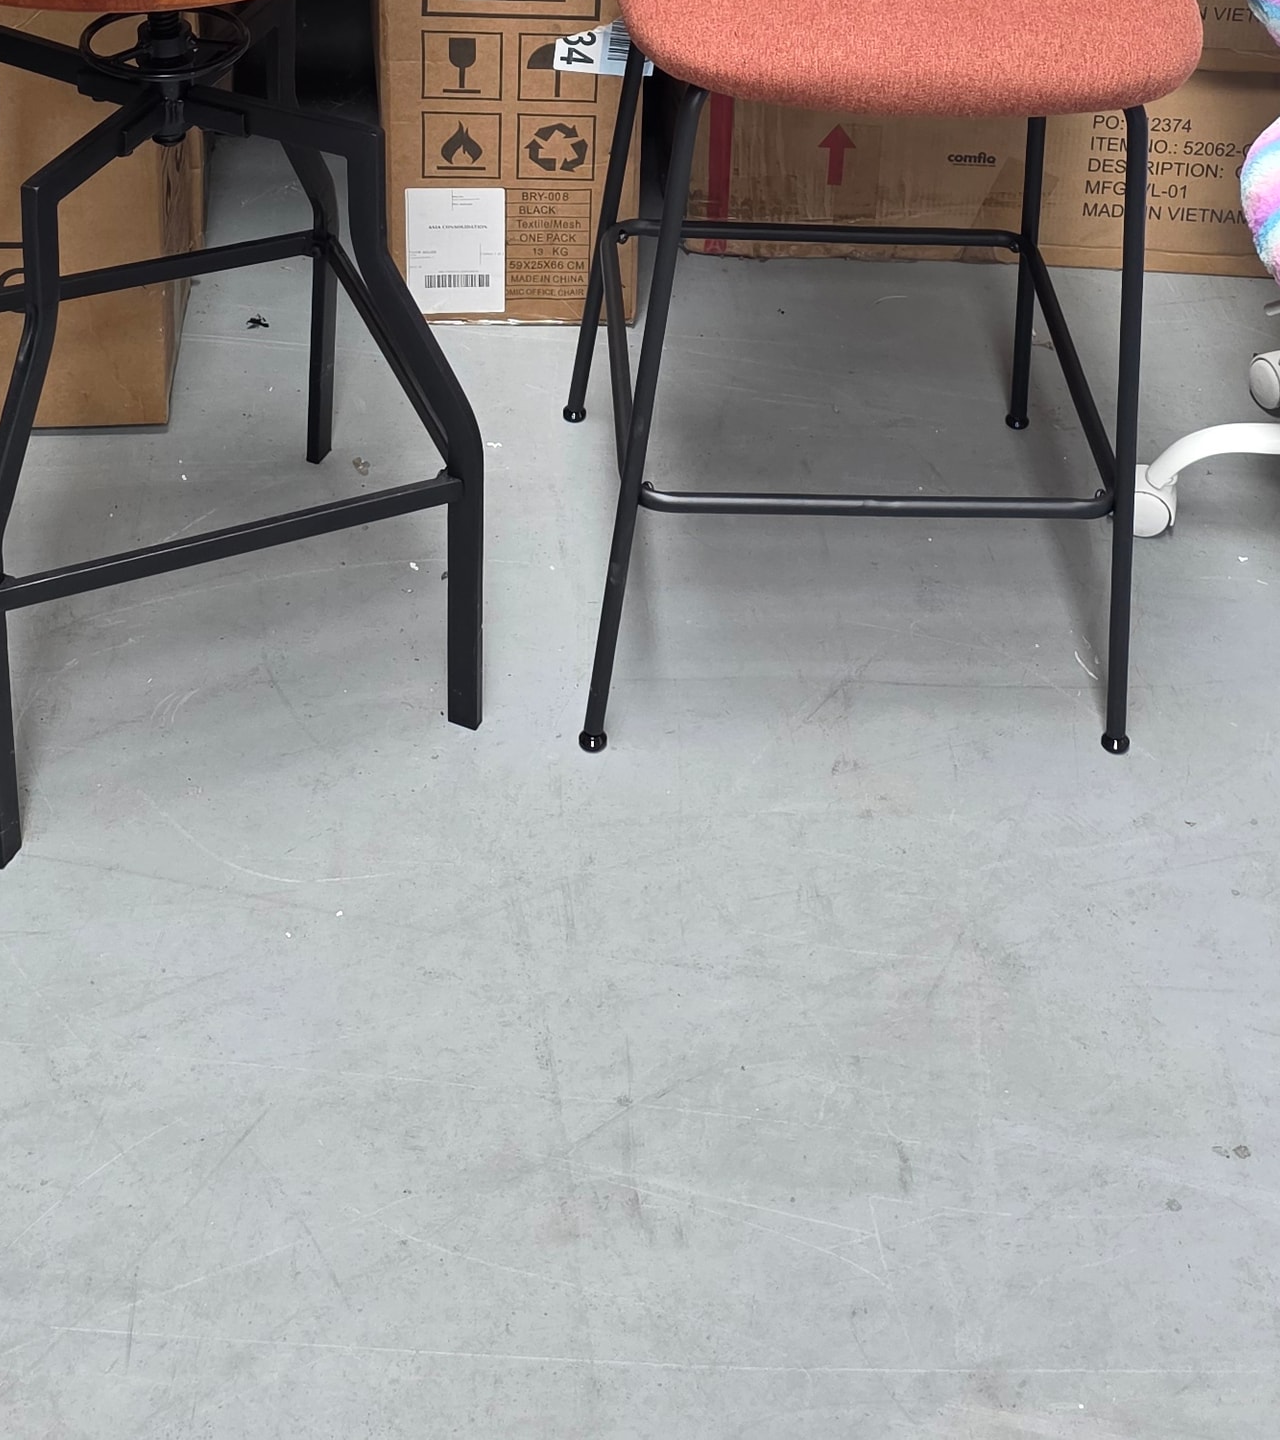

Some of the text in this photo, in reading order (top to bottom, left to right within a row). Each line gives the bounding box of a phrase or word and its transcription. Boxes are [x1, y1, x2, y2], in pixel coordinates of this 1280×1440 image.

[1146, 117, 1192, 133] 2374
[1087, 158, 1224, 178] DESRIPTION:
[1085, 180, 1126, 196] MFG
[522, 192, 569, 202] BRY-008
[519, 206, 556, 215] BLACK
[1082, 203, 1125, 219] MAD
[516, 219, 581, 229] Textile/Mesh
[520, 233, 577, 242] ONE PACK
[552, 247, 569, 256] KG
[509, 261, 585, 270] 59X25X66 CM
[510, 275, 539, 283] MADE
[553, 275, 584, 283] CHINA
[526, 288, 556, 297] OFFICE
[558, 288, 584, 297] CHAIR
